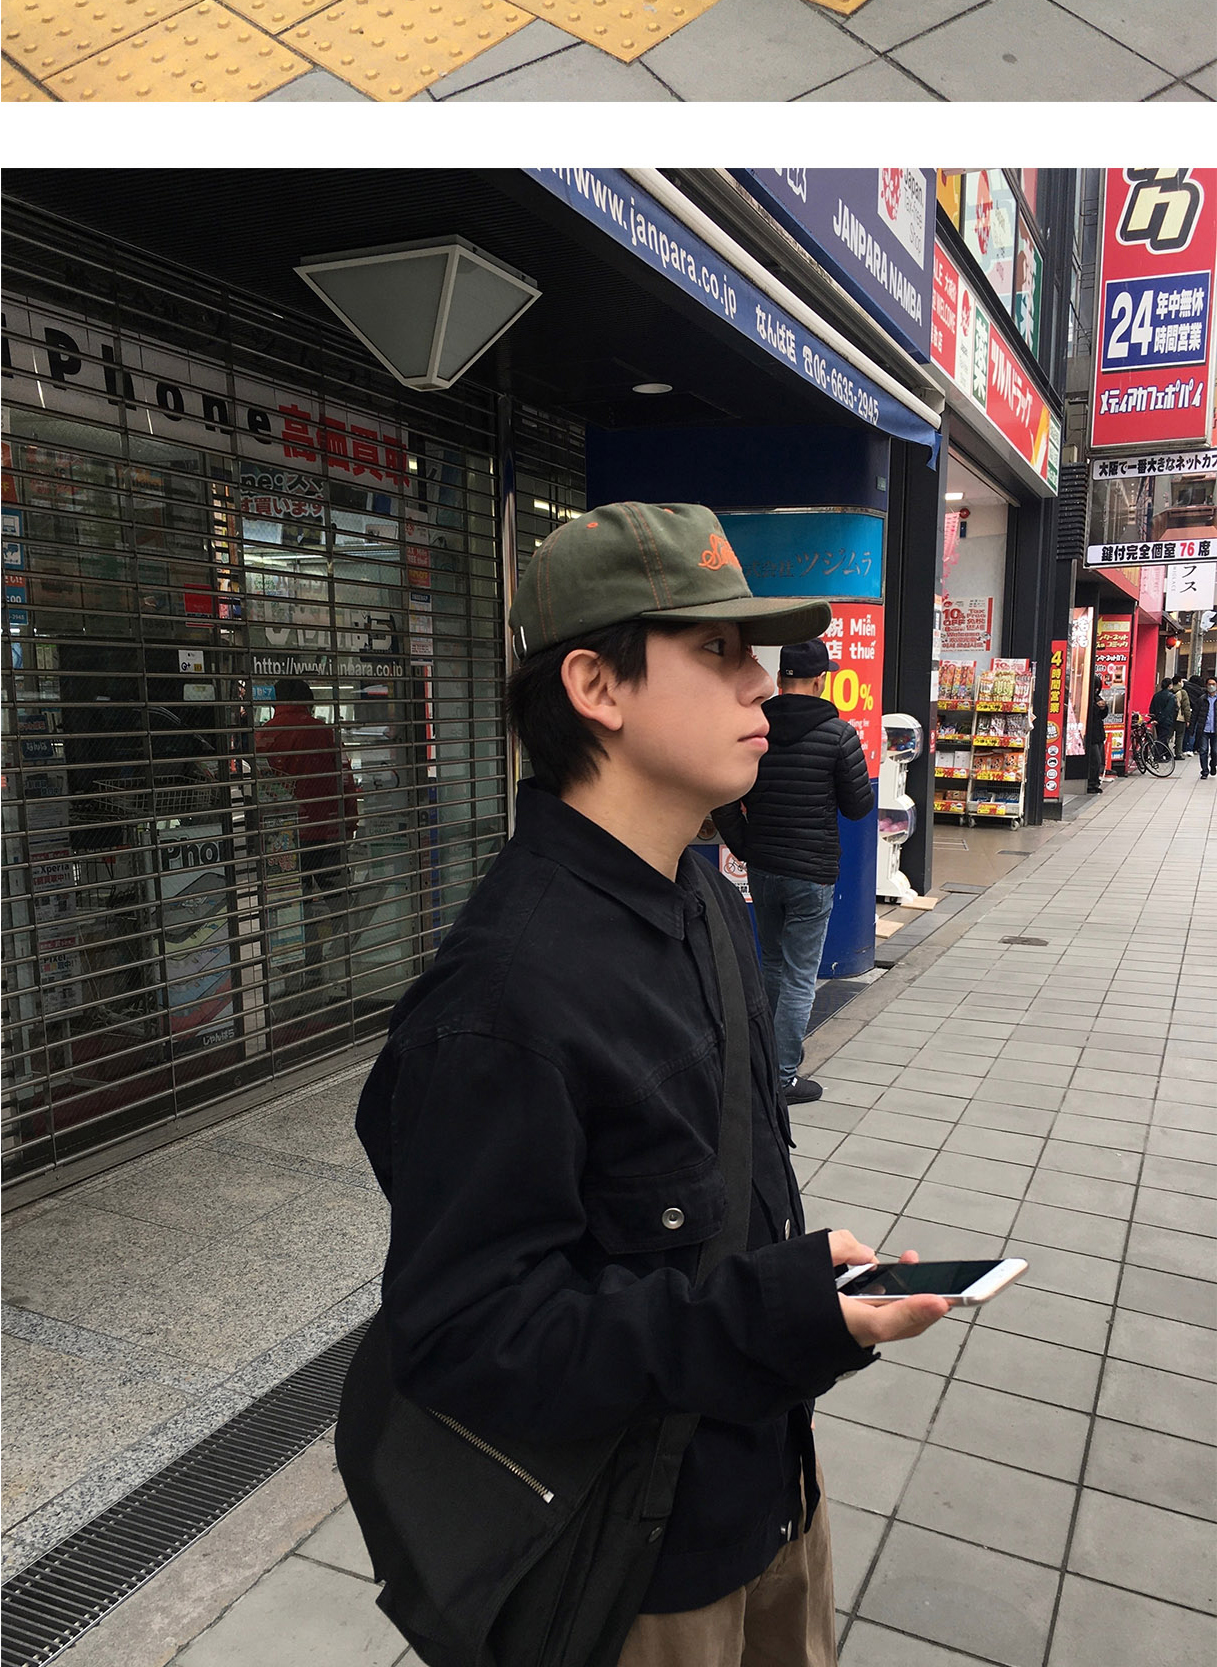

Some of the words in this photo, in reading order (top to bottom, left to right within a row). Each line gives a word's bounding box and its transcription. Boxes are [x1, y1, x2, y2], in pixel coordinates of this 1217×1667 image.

[833, 198, 888, 290] JANPARA
[889, 260, 923, 327] NAMBA
[1107, 289, 1154, 359] 24
[1156, 287, 1205, 320] 年中無休
[755, 304, 797, 365] なんば店
[1154, 322, 1203, 354] 時間営業
[991, 337, 1033, 429] ツルハドラッグ
[278, 404, 410, 488] 高価買取
[1101, 542, 1176, 562] 鍵付完全個室
[1179, 542, 1195, 557] 76
[1197, 540, 1211, 557] 席
[849, 614, 876, 637] Miễn
[849, 640, 876, 660] thuế
